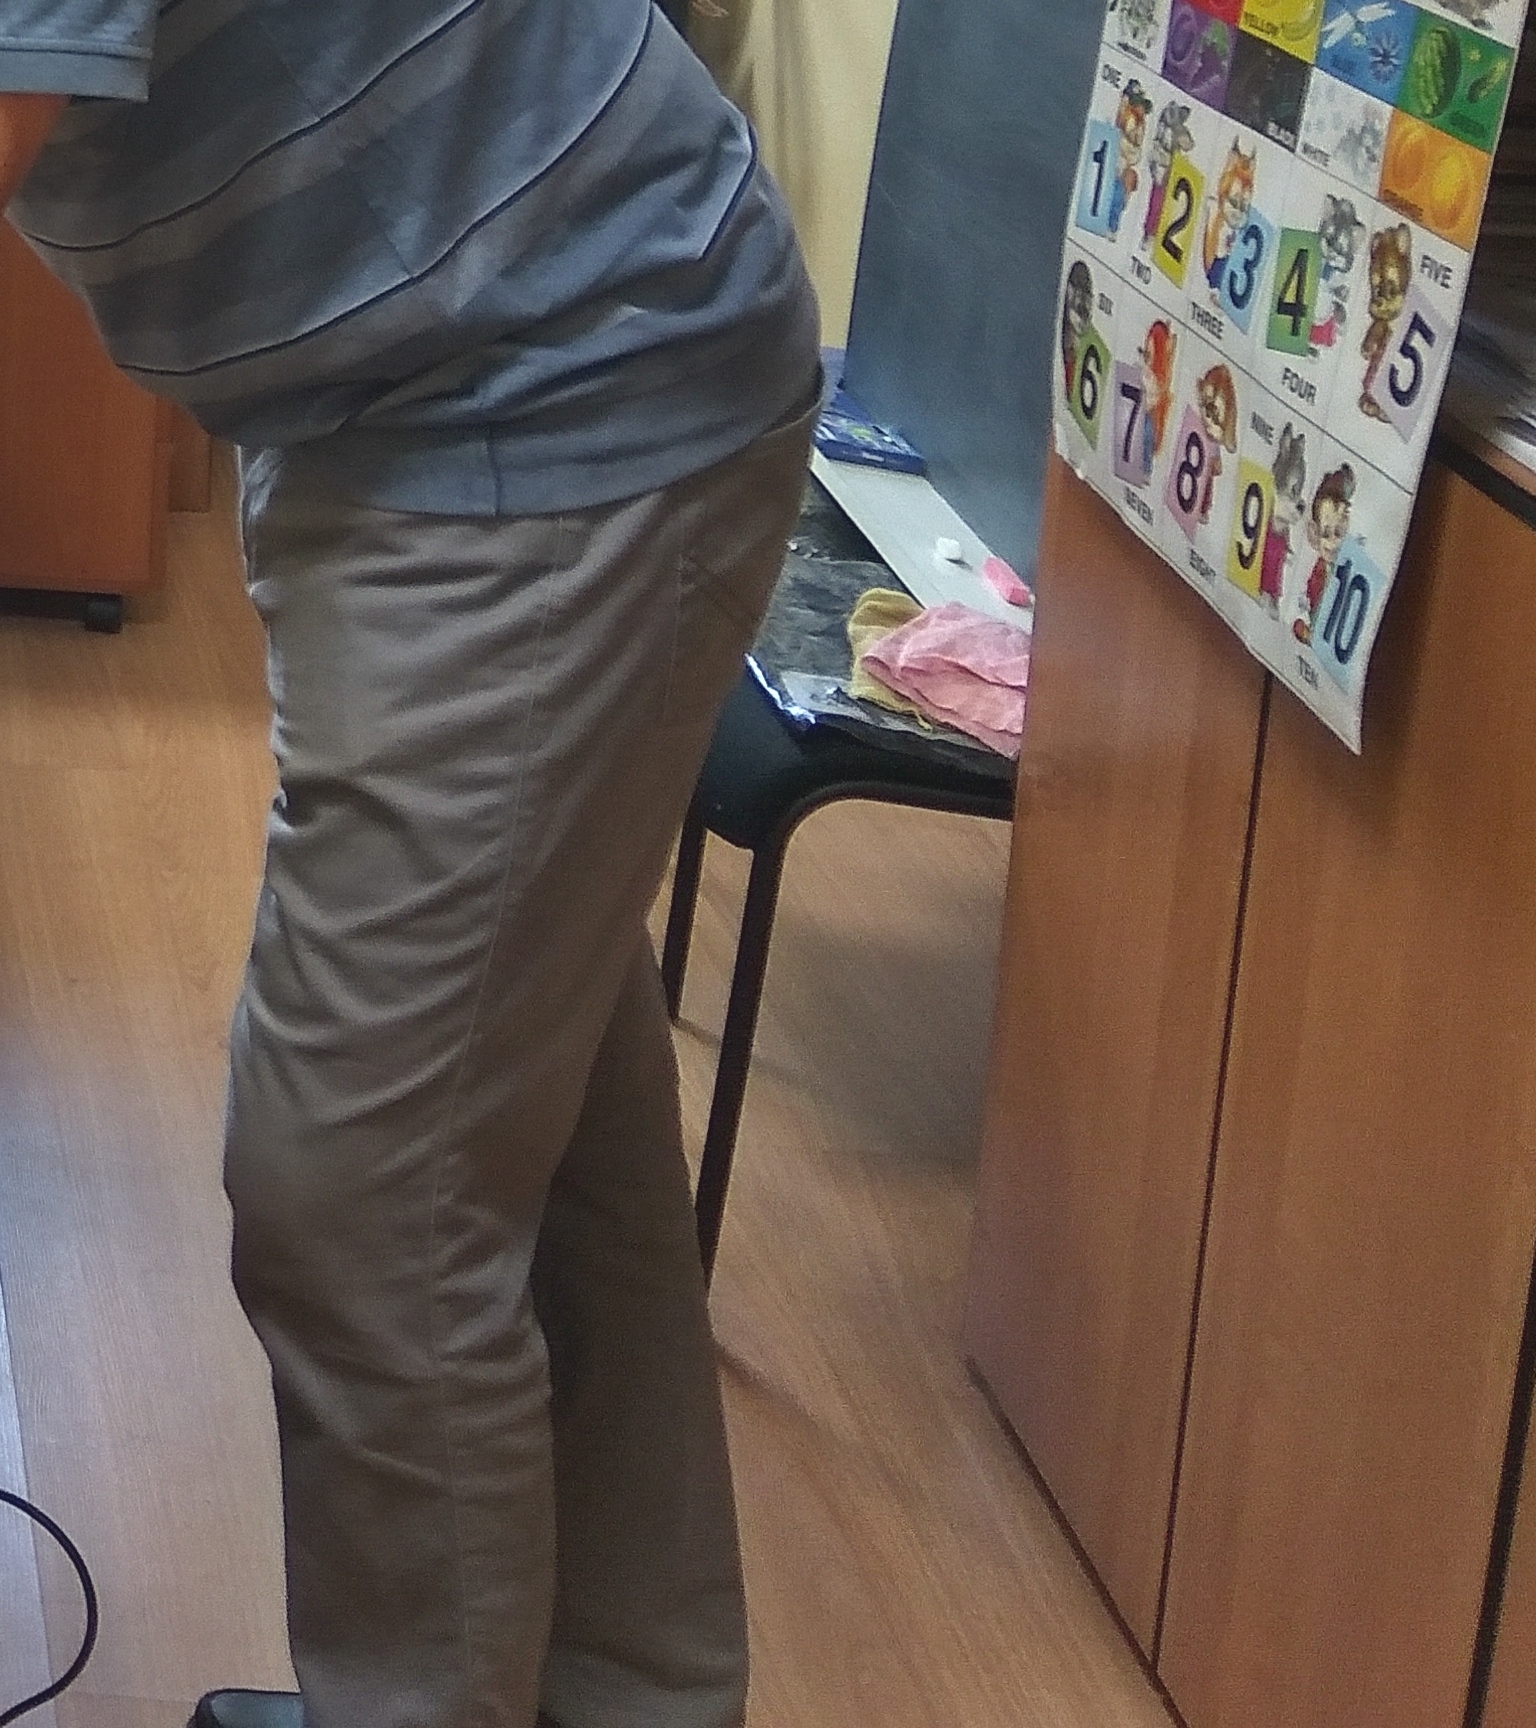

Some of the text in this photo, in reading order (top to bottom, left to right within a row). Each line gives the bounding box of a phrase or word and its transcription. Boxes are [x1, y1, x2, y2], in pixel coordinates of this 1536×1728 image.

[1101, 63, 1123, 90] ONE
[1091, 139, 1109, 218] 1
[1161, 176, 1192, 263] 2
[1130, 255, 1153, 286] TWO
[1228, 224, 1264, 310] 3
[1276, 247, 1310, 337] 4
[1419, 253, 1453, 289] FIVE
[1098, 290, 1114, 317] SIX
[1190, 301, 1225, 341] THREE
[1079, 343, 1100, 421] 6
[1280, 366, 1317, 406] FOUR
[1388, 310, 1436, 408] 5
[1119, 381, 1143, 463] 7
[1250, 411, 1274, 446] NINE
[1175, 430, 1205, 514] 8
[1124, 488, 1154, 527] SEVEN
[1236, 481, 1265, 570] 9
[1188, 548, 1218, 584] EIGHT
[1322, 558, 1372, 666] 10
[1298, 654, 1319, 691] TEN
